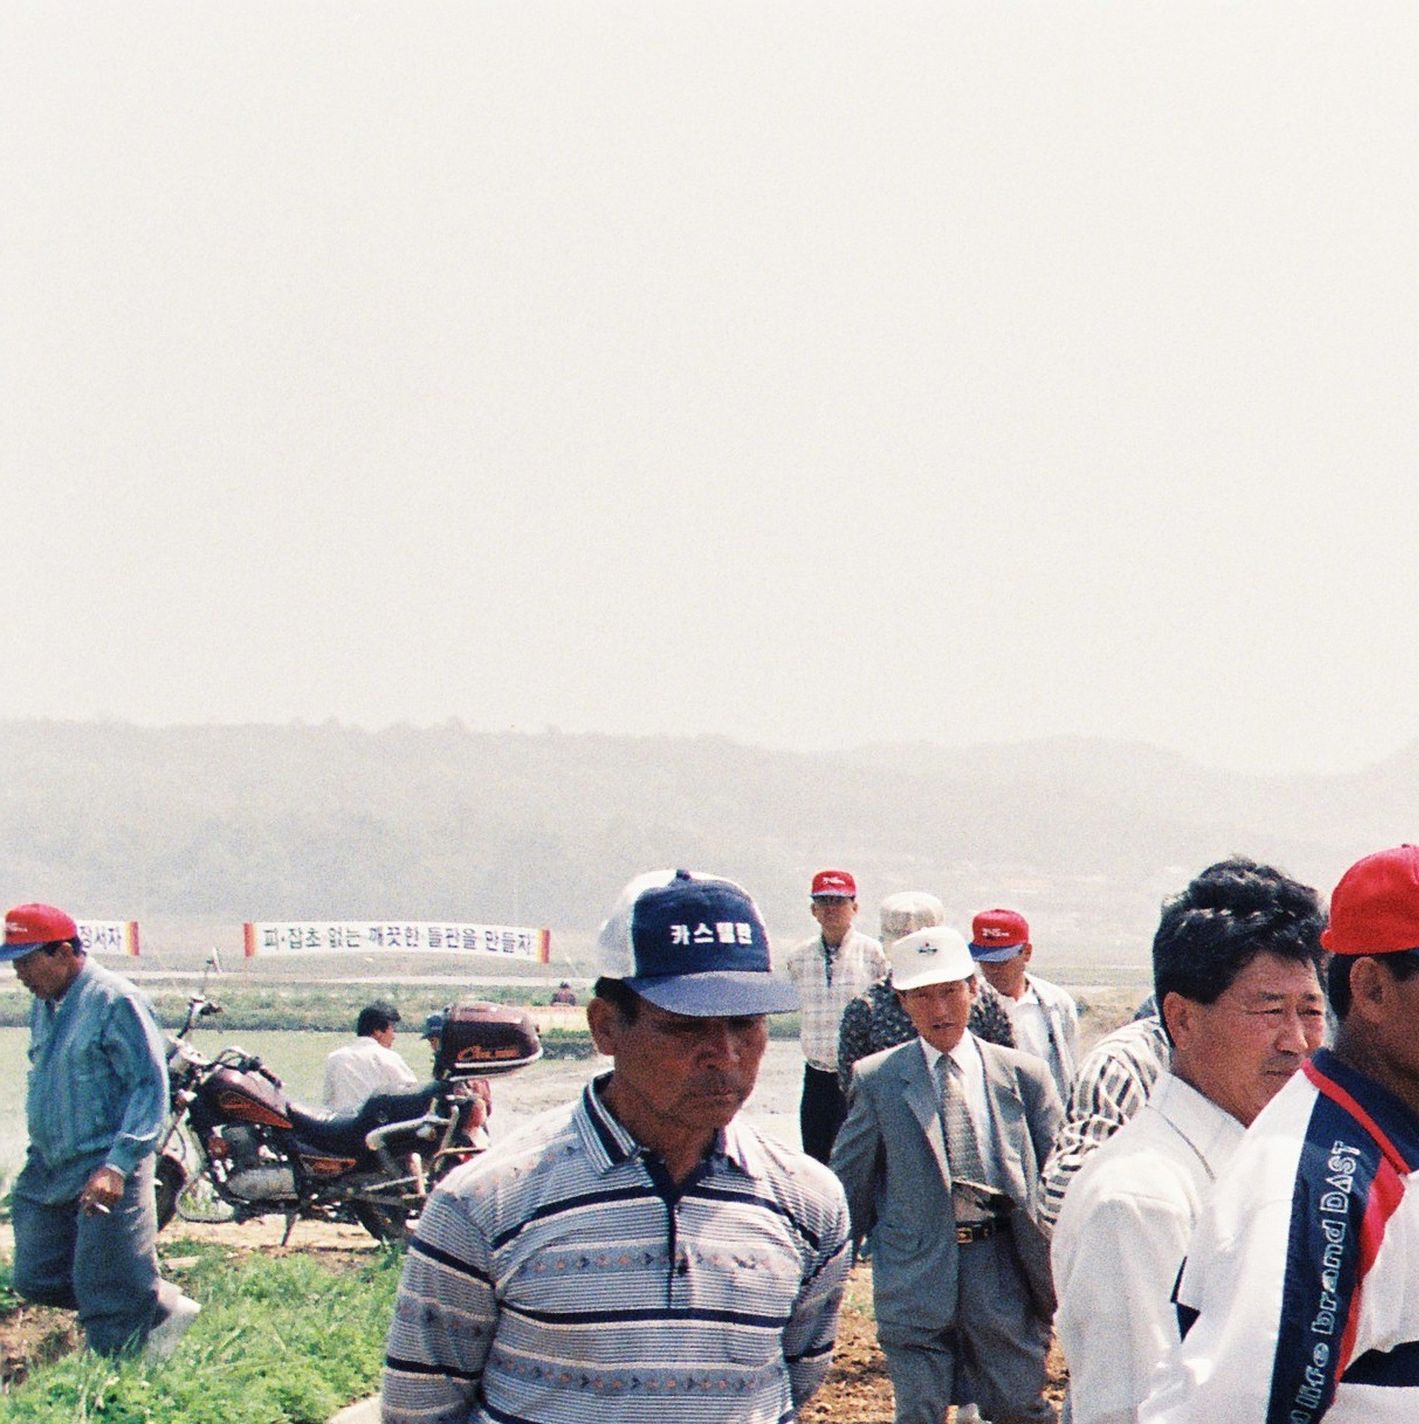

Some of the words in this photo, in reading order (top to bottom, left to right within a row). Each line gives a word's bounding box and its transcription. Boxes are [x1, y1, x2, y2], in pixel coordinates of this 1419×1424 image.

[328, 926, 360, 949] 없는
[369, 925, 419, 948] 깨끗한
[428, 926, 478, 950] 들판을
[485, 930, 532, 956] 만들자
[1319, 1140, 1361, 1214] DAST
[1311, 1219, 1347, 1336] brand
[1295, 1342, 1331, 1410] life
